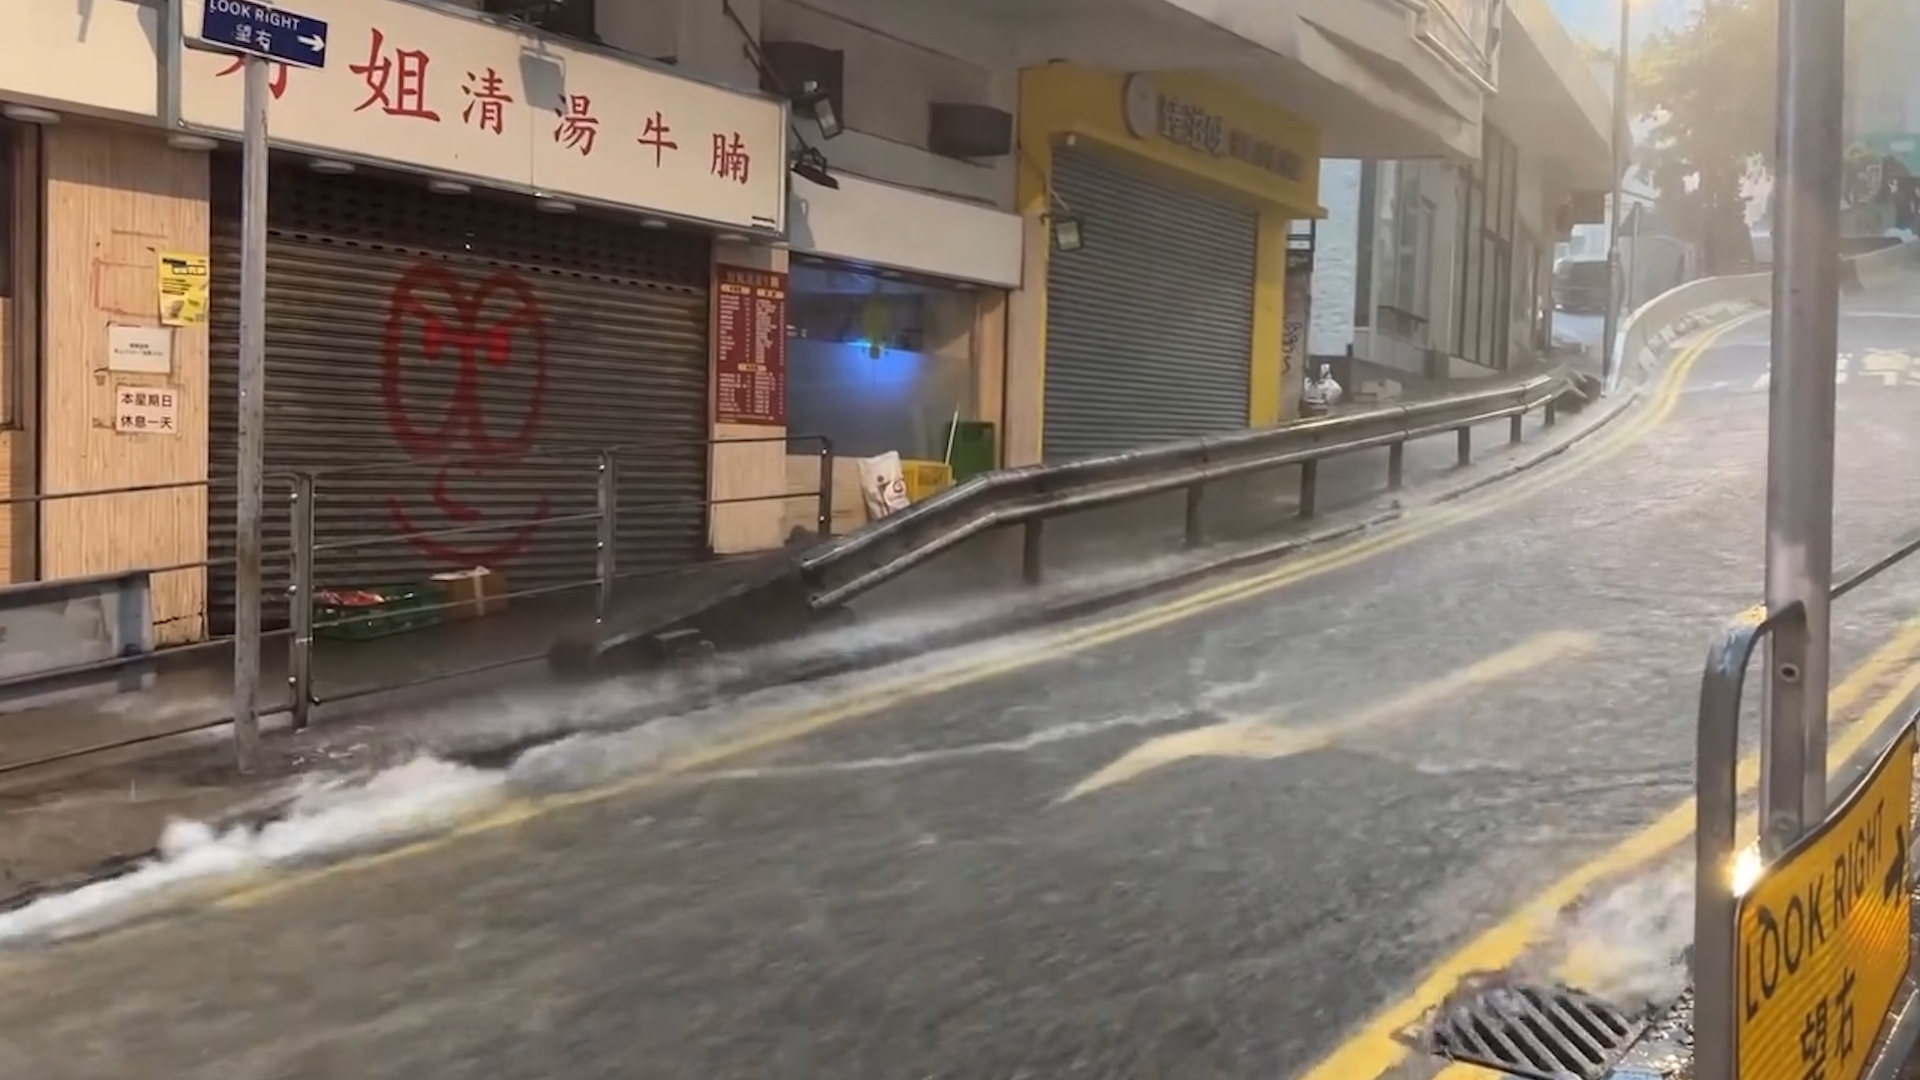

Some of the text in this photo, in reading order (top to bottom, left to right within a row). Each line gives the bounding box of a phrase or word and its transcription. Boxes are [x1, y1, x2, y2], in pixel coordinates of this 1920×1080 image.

[209, 0, 300, 31] LOOK RIGHT
[235, 23, 272, 51] 望右
[215, 28, 751, 185] 姐清湯牛腩
[121, 392, 172, 407] 本星期日
[121, 414, 172, 429] 休息一天
[1746, 798, 1884, 1022] LOOK RIGHT
